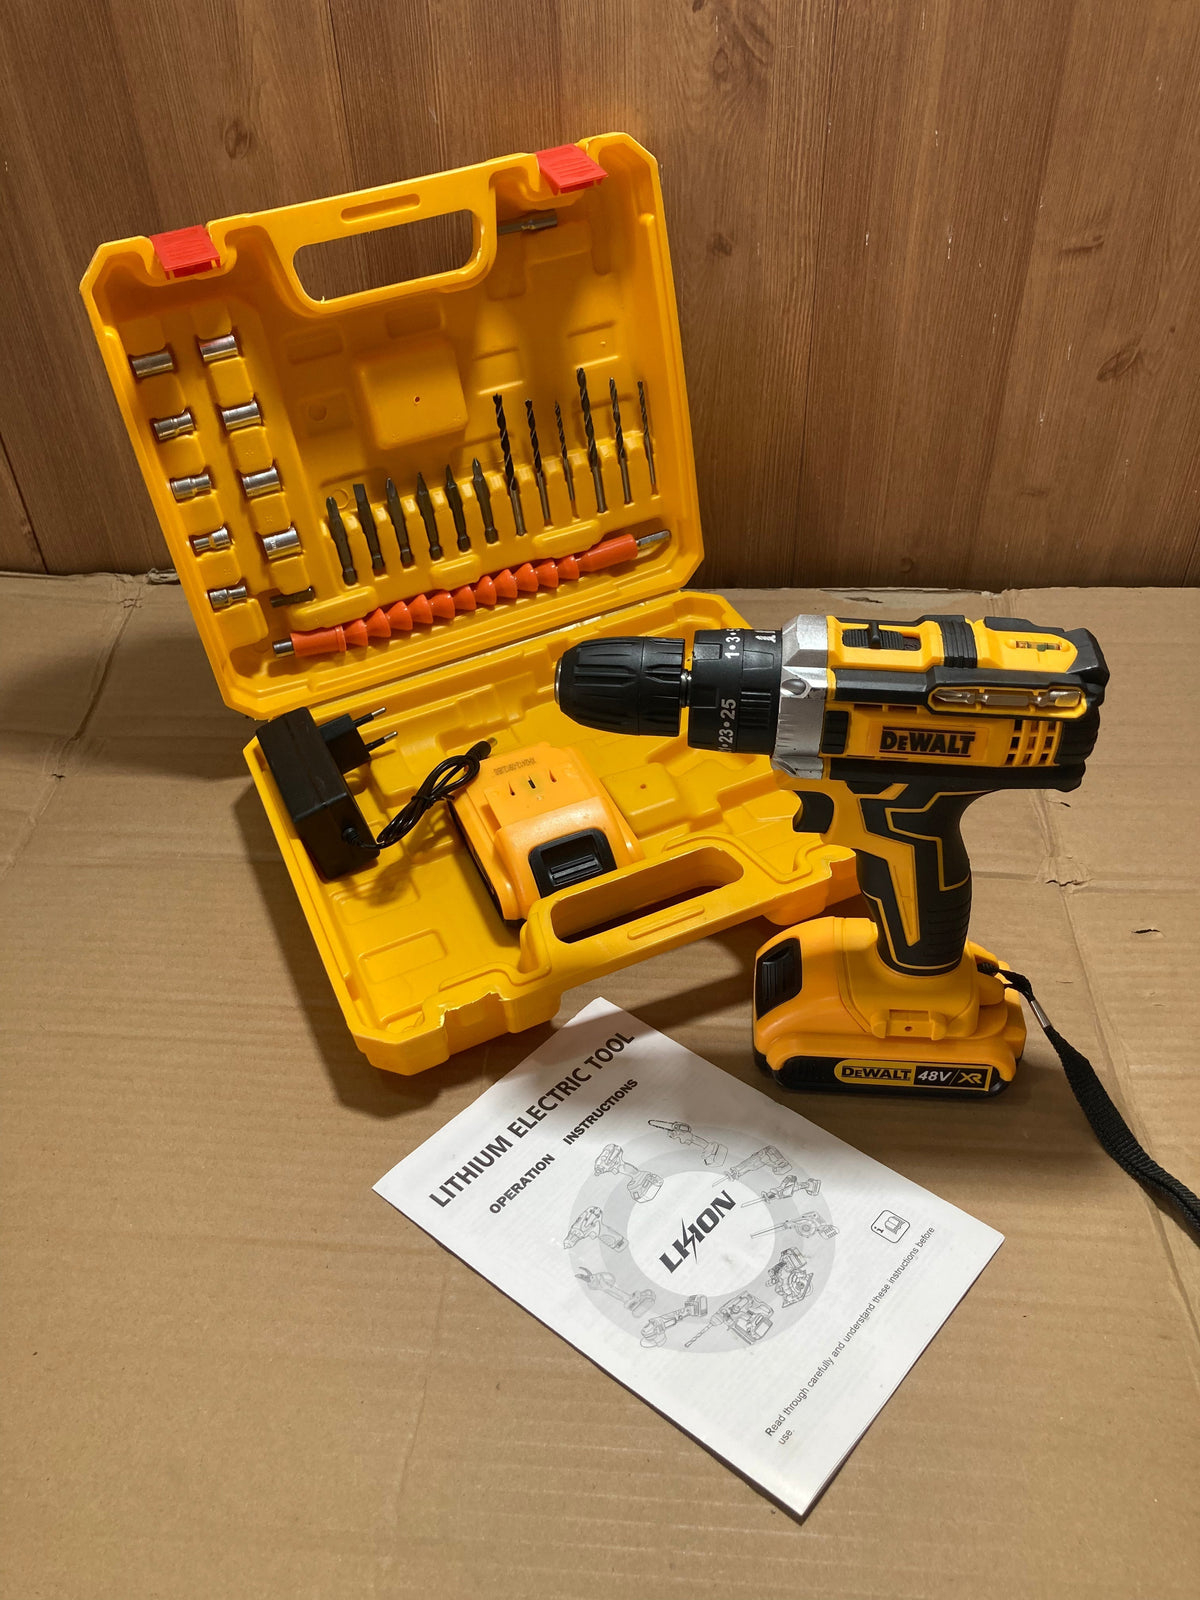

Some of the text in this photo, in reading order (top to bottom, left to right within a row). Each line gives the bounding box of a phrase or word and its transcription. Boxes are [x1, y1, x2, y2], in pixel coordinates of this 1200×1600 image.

[428, 1032, 635, 1208] LITHIUM ELECTRIC TOOL
[489, 1078, 639, 1214] OPERATION INSTRUCTIONS
[917, 1070, 953, 1083] 48V
[764, 1226, 935, 1437] Read through carefully and understand these instructions before
